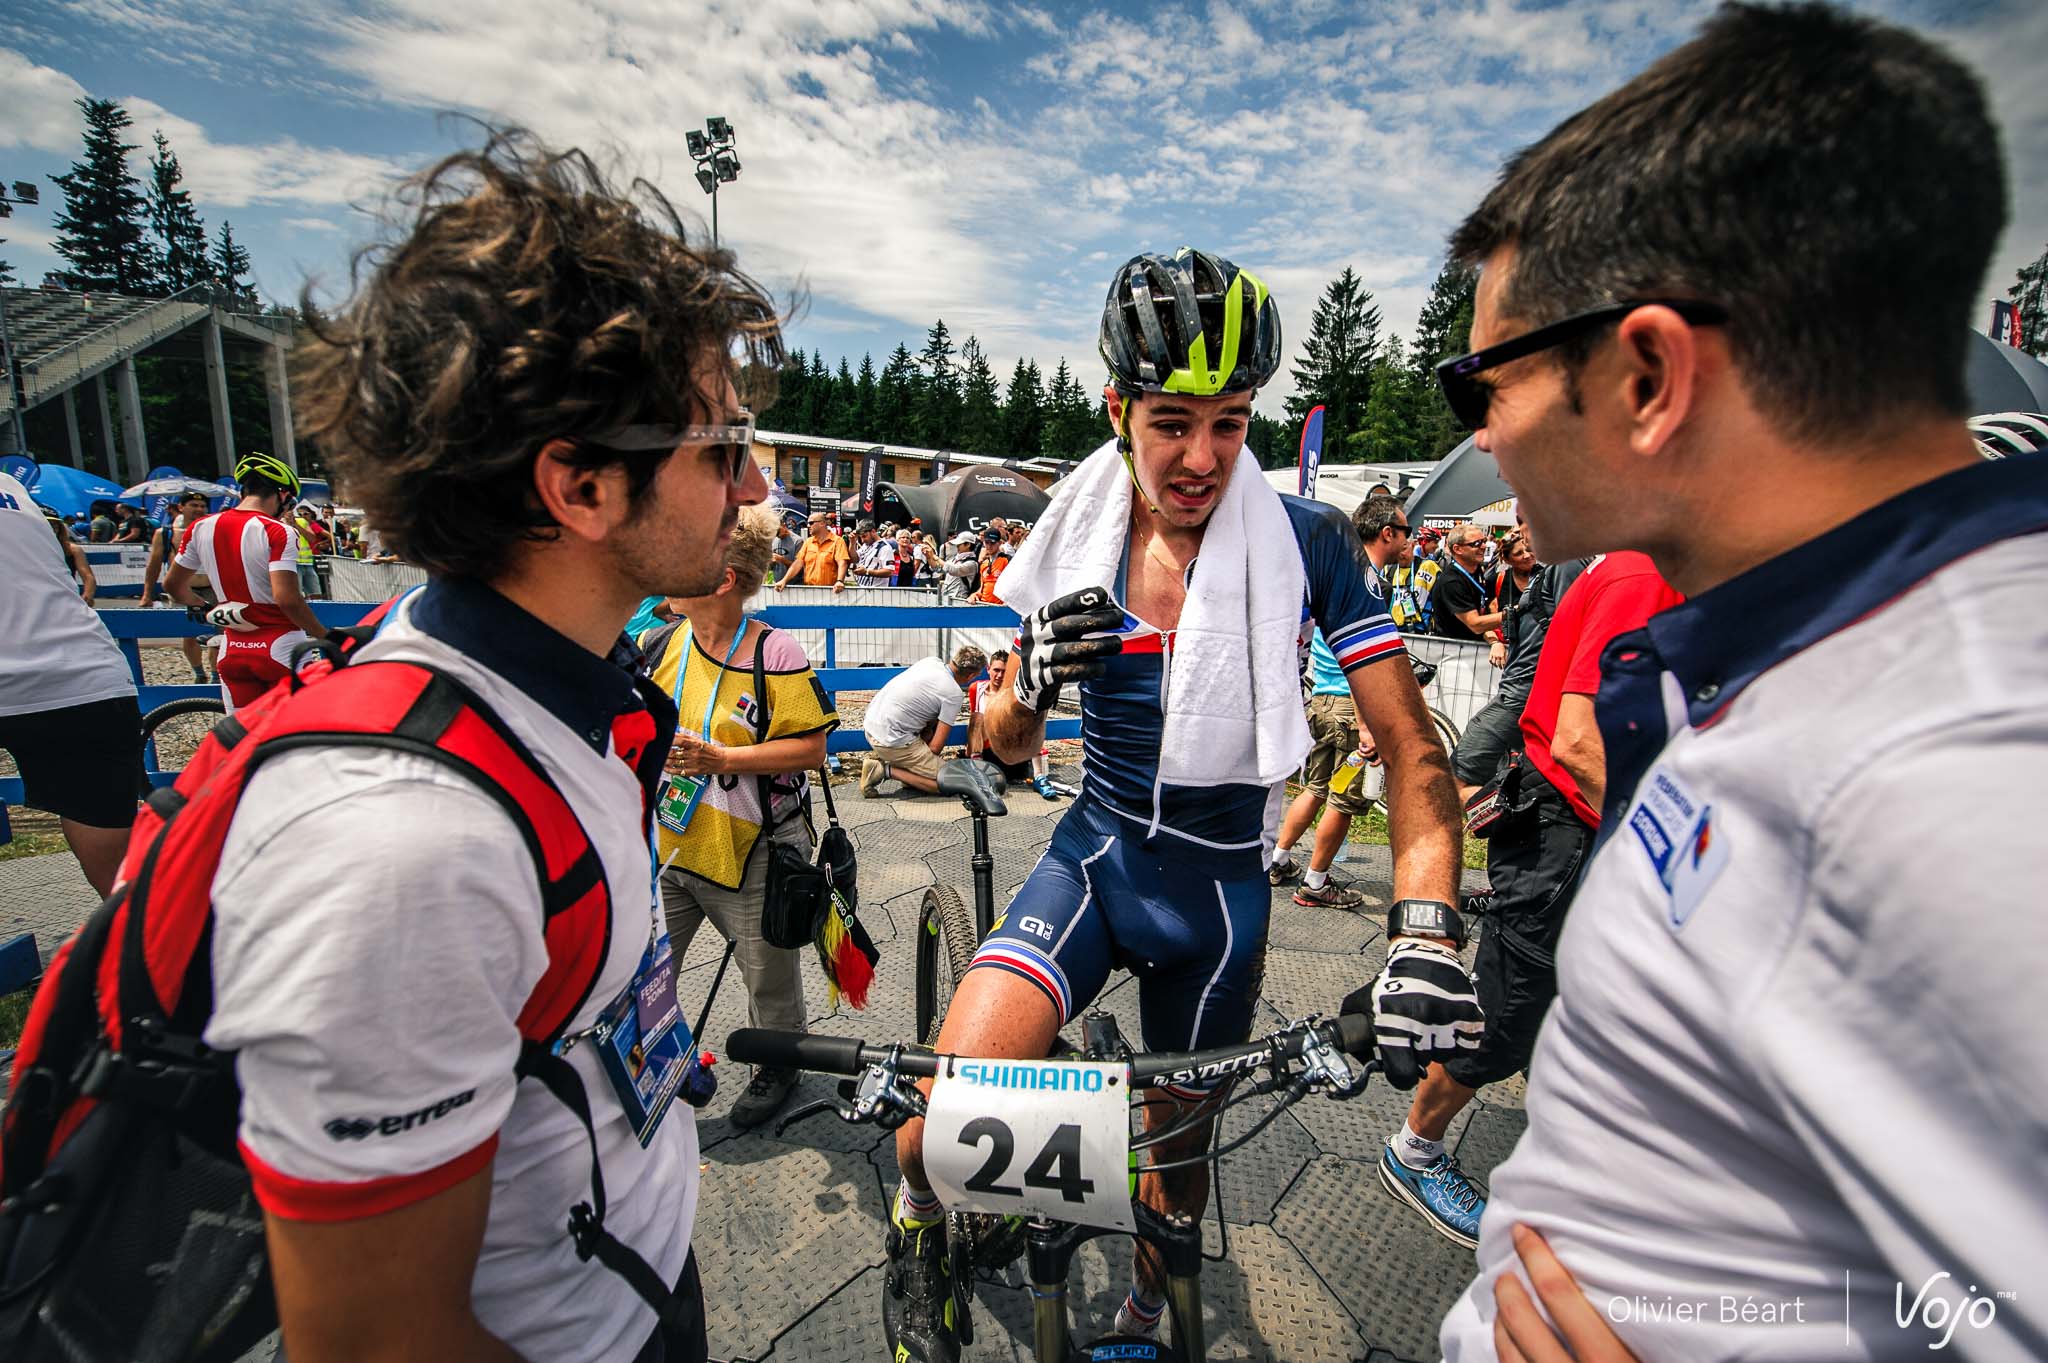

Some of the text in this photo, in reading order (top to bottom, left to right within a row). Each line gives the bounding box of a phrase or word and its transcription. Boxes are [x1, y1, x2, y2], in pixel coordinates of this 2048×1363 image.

[866, 459, 877, 500] KROSS
[975, 474, 1016, 483] GoPro
[213, 609, 242, 626] 81
[229, 641, 267, 649] POLSKA
[647, 980, 668, 1007] ZONE
[960, 1064, 1103, 1093] SHIMANO
[957, 1117, 1095, 1204] 24
